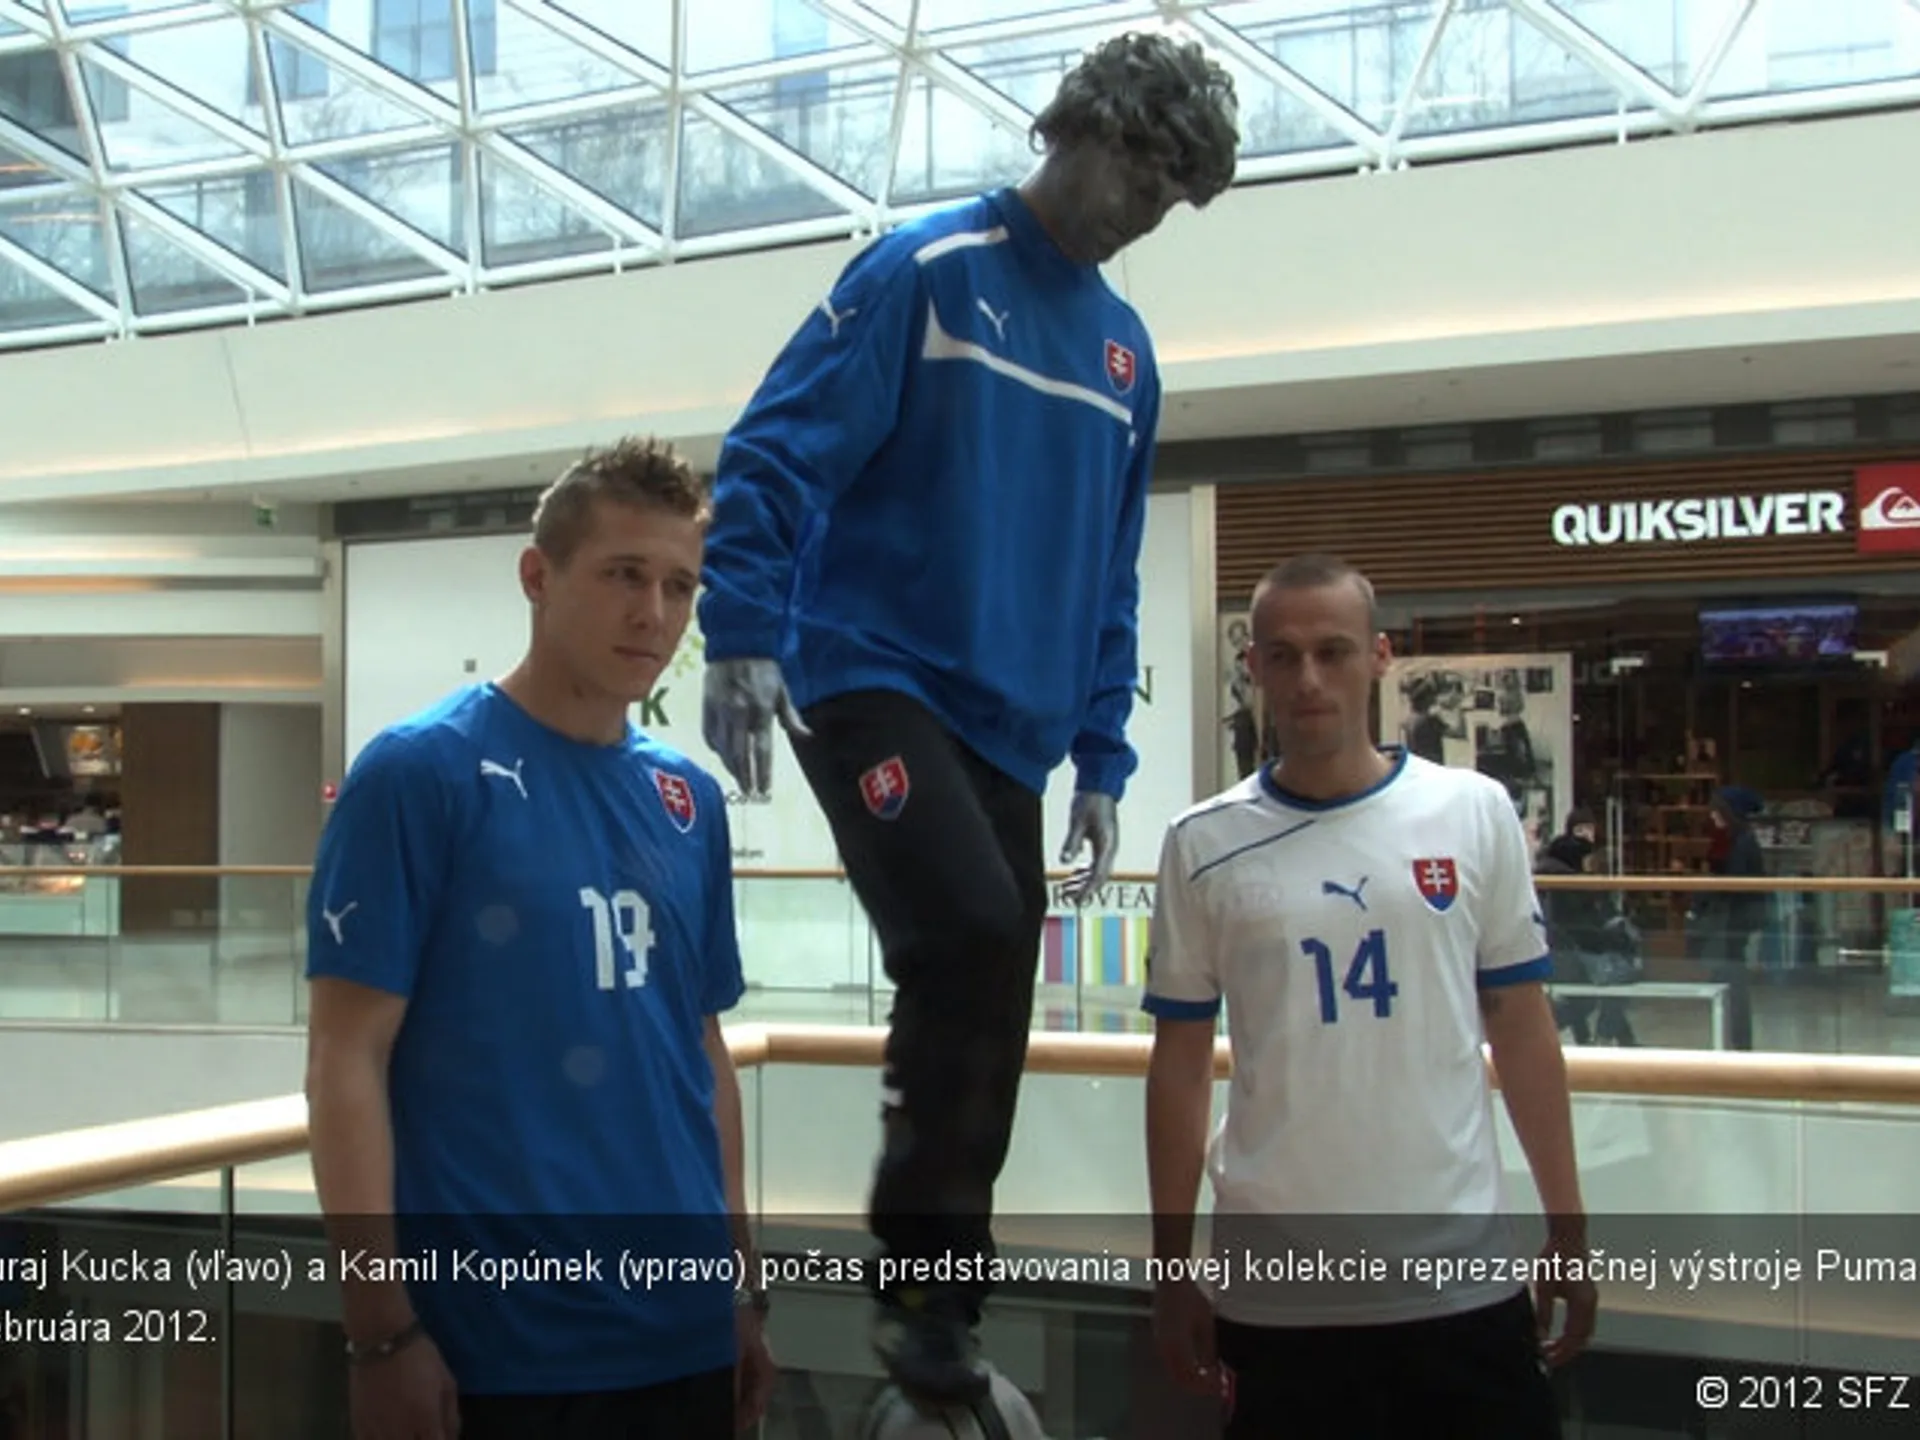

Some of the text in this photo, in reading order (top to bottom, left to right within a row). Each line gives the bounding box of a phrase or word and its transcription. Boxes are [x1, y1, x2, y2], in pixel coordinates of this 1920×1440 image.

[1552, 491, 1844, 545] QUIKSILVER
[1134, 665, 1154, 706] N
[1051, 885, 1153, 910] ROVEA
[578, 886, 656, 990] 19
[1299, 928, 1399, 1024] 14
